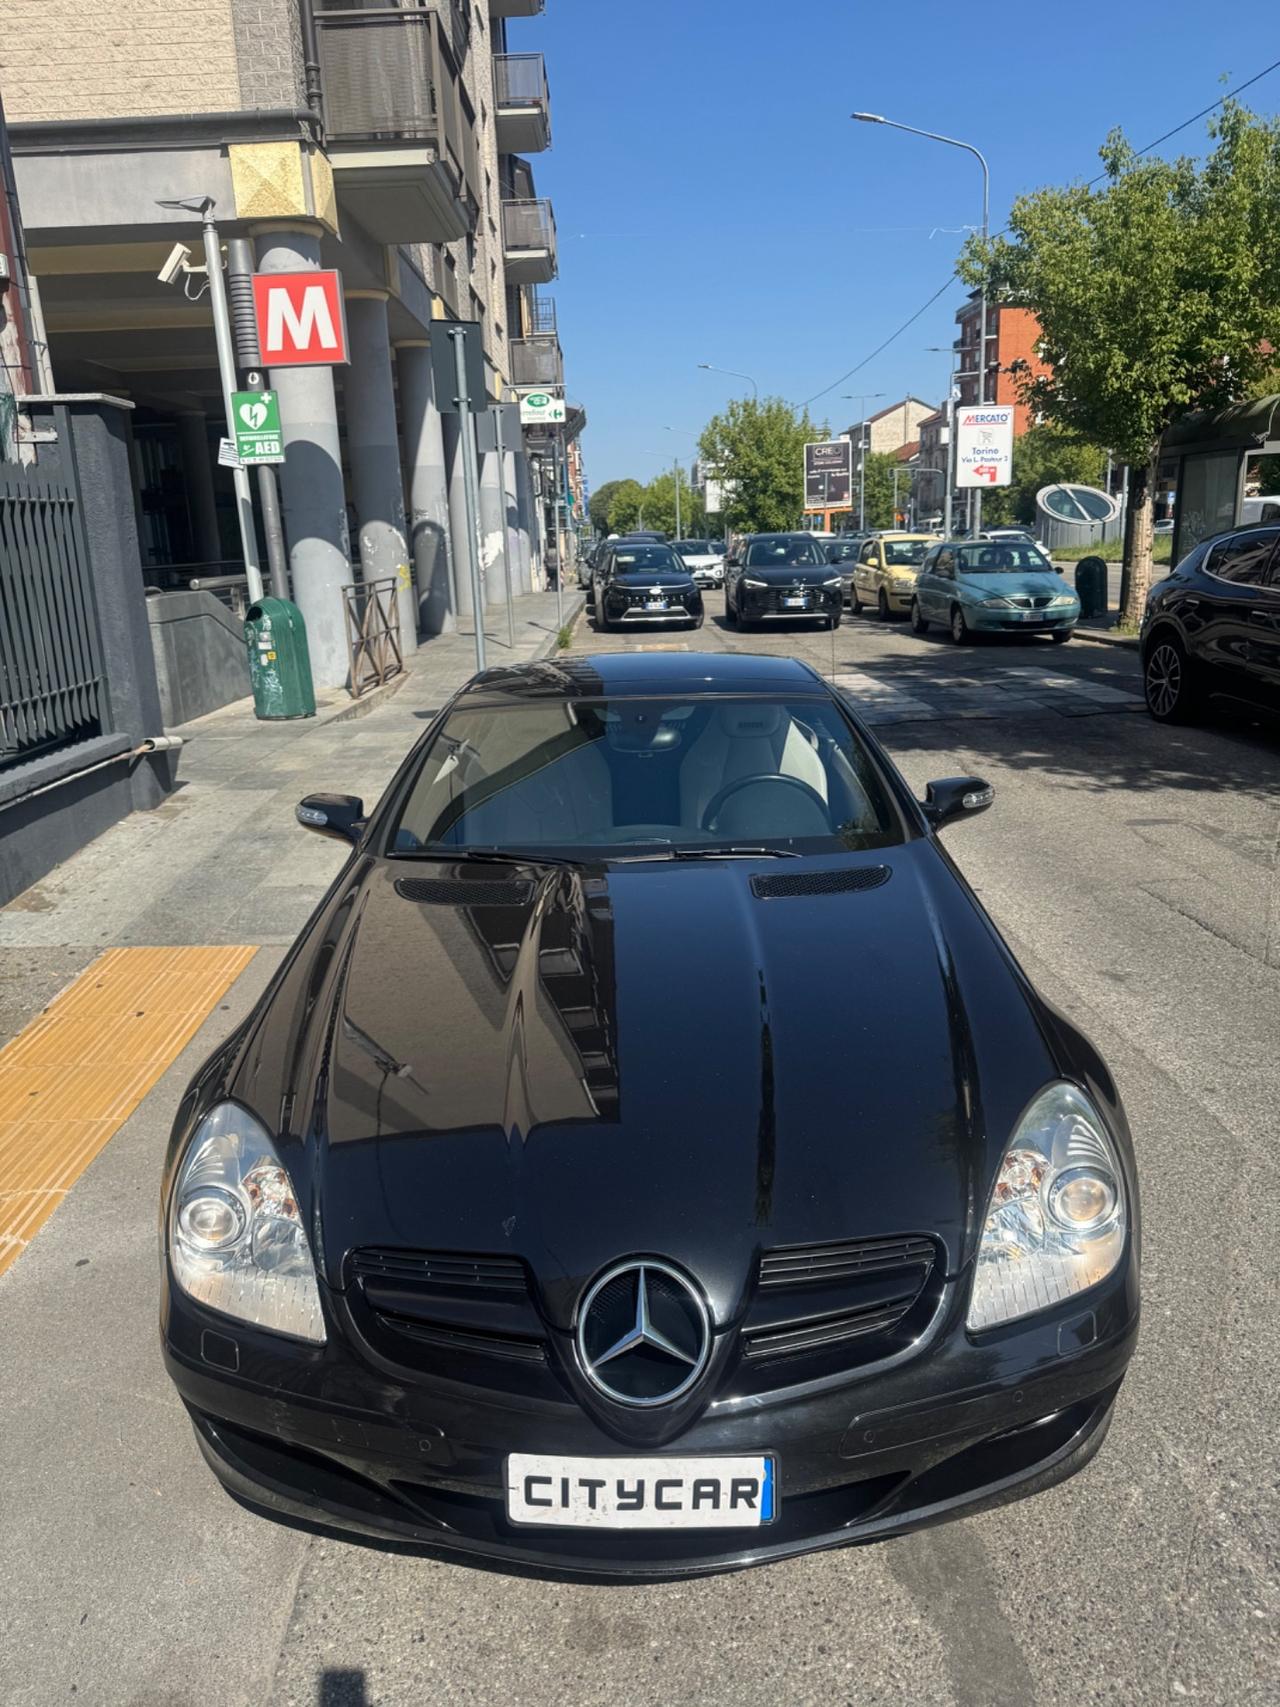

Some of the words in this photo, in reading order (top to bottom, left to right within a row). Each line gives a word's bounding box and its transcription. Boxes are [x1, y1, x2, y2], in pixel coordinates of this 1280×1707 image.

[267, 286, 338, 351] M
[962, 413, 1009, 426] MERCATO
[255, 441, 280, 455] AED
[972, 446, 999, 455] Torino
[524, 1475, 759, 1510] CITYCAR
